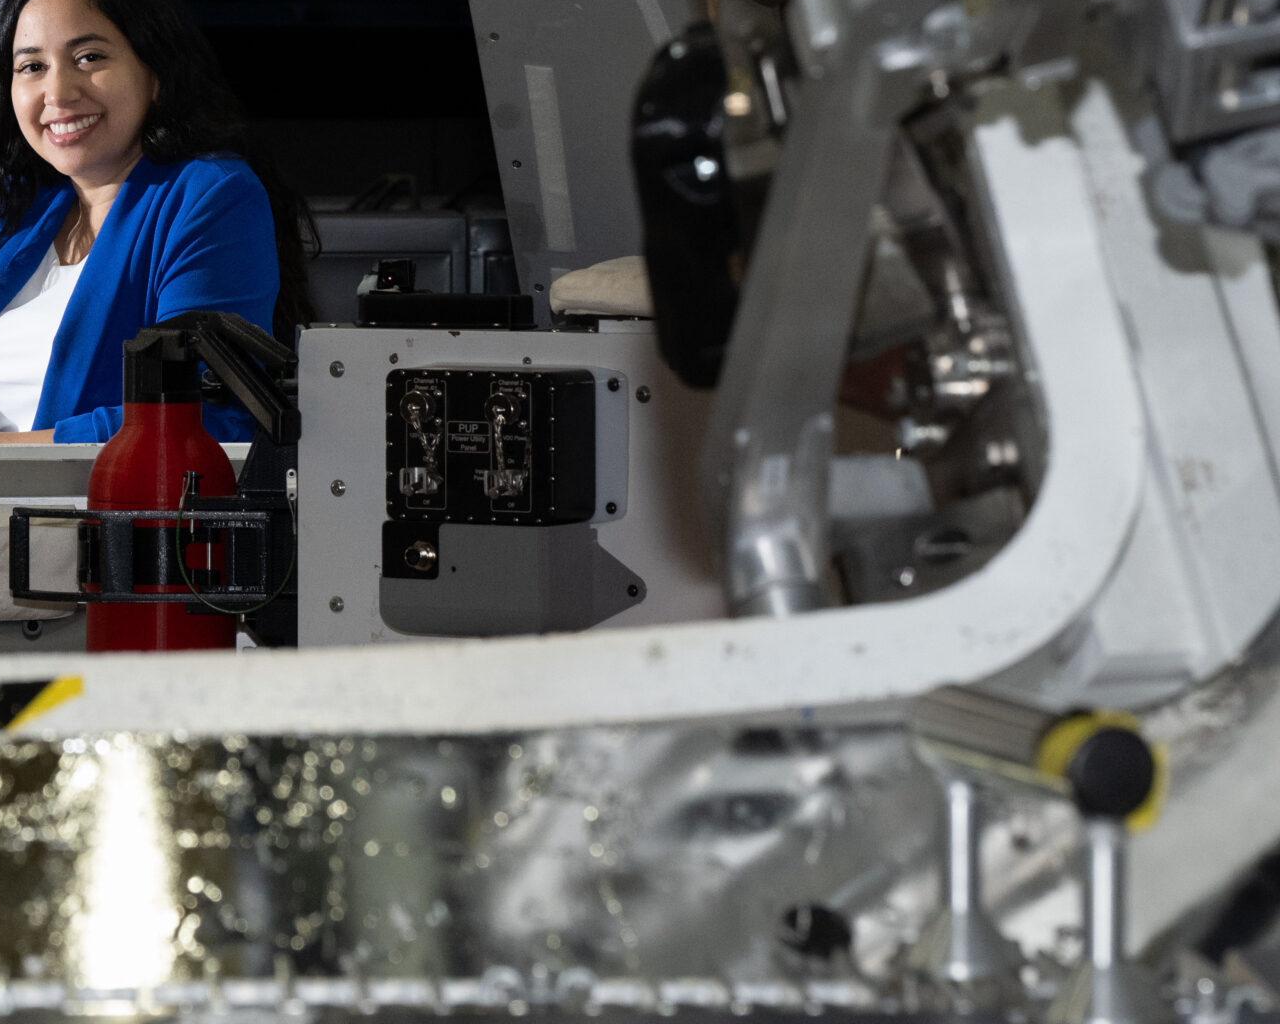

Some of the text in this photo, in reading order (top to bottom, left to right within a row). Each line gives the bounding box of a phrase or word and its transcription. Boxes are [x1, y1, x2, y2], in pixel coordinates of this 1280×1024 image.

[458, 424, 479, 433] PUP
[451, 434, 486, 444] Power Utility
